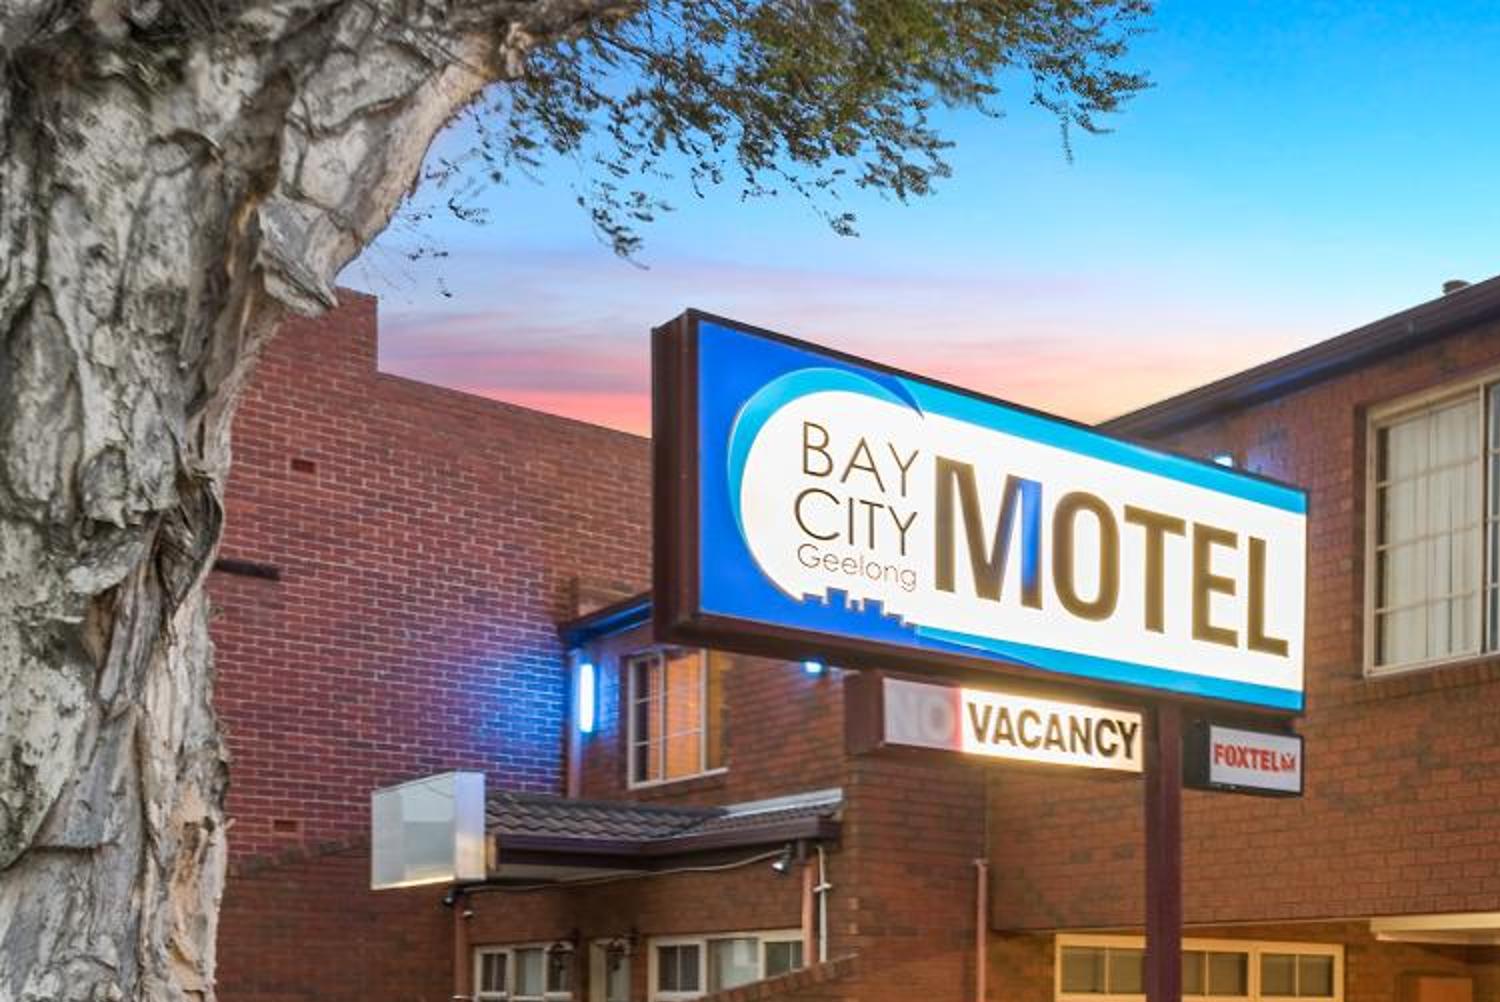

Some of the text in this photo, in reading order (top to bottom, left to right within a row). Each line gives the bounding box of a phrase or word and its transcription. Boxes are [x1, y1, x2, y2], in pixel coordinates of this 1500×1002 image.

[802, 421, 920, 497] BAY
[794, 488, 918, 556] CITY
[797, 543, 917, 591] Geelong
[935, 455, 1289, 658] MOTEL
[967, 701, 1138, 760] VACANCY
[1214, 743, 1280, 772] FOXTEL
